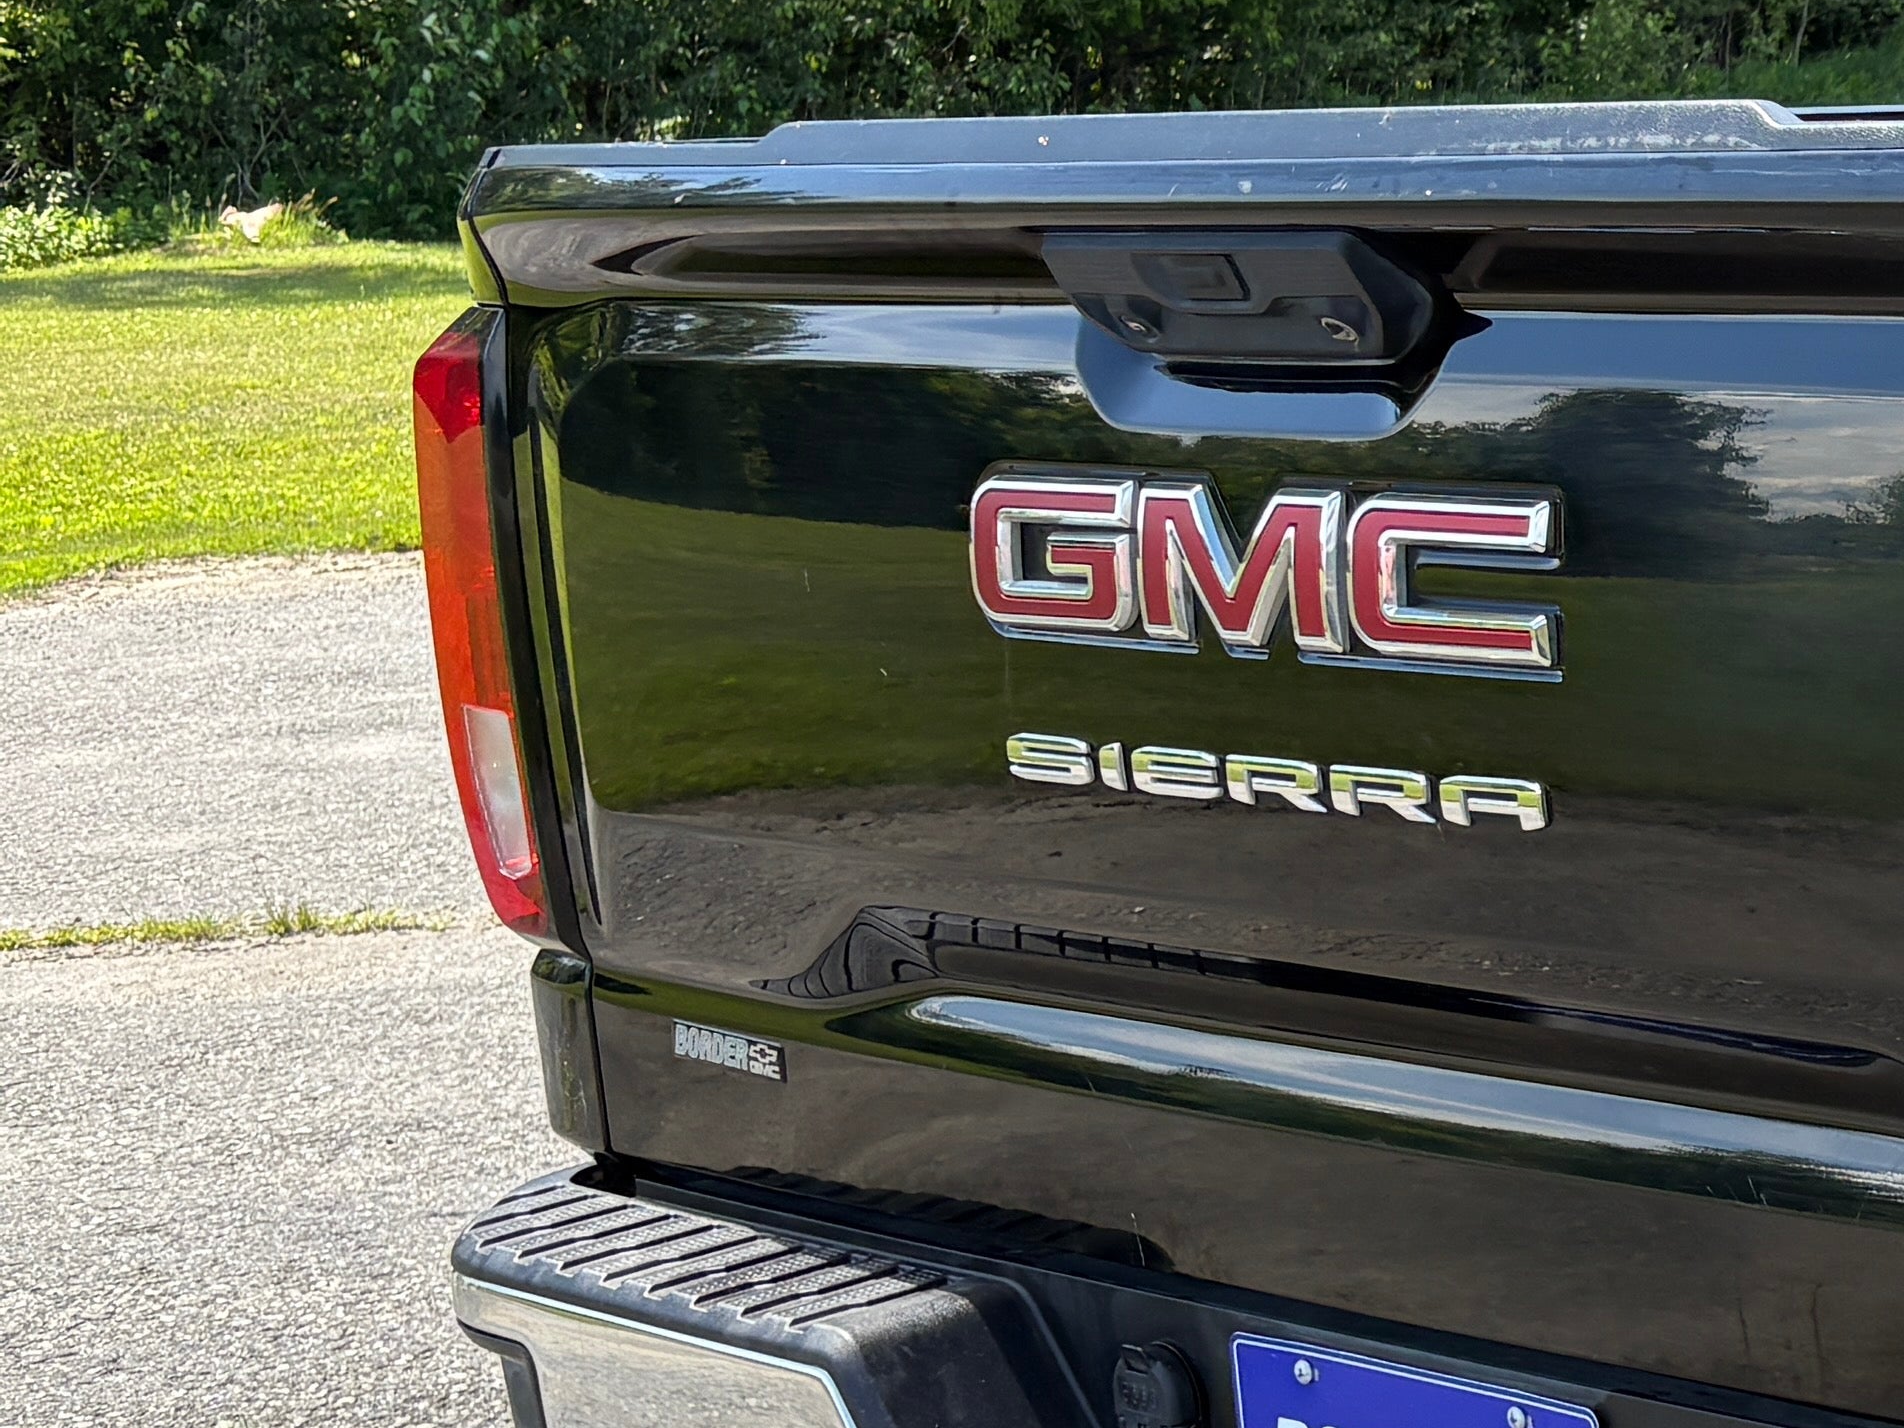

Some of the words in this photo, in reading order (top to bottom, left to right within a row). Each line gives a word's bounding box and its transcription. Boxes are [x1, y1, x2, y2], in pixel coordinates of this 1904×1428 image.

[970, 475, 1555, 669] GMC
[1006, 732, 1552, 832] SIERRA
[674, 1023, 749, 1072] BORDER
